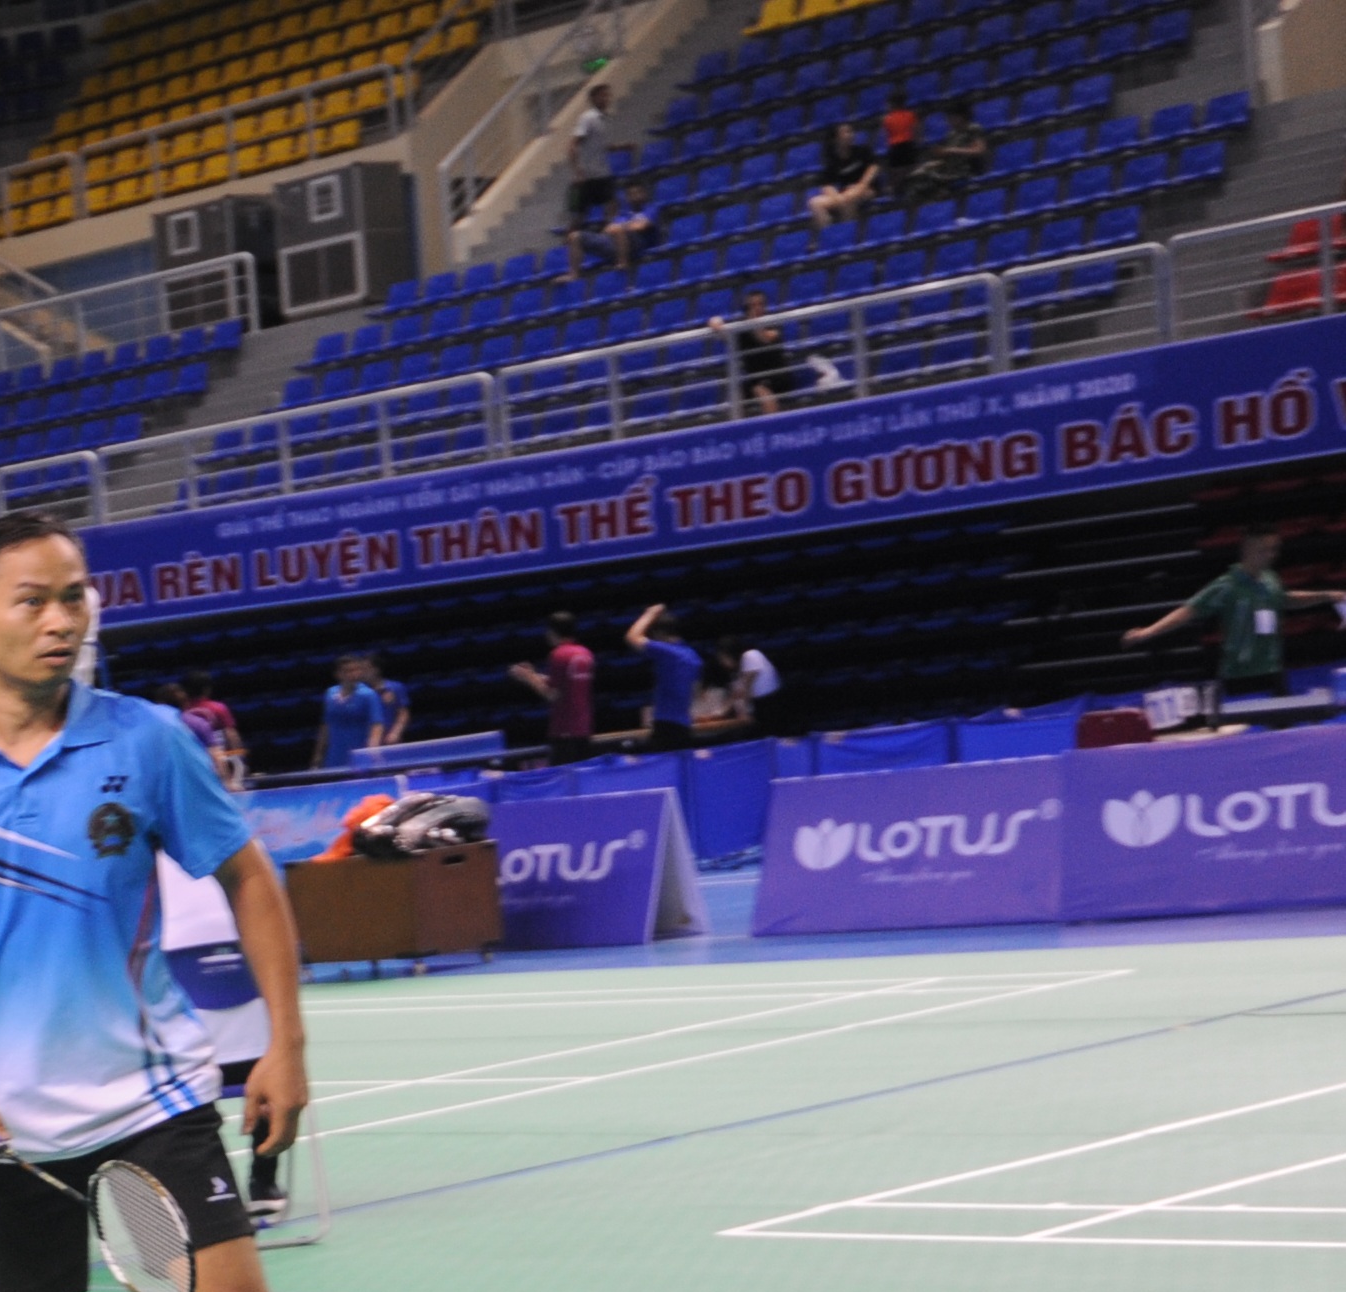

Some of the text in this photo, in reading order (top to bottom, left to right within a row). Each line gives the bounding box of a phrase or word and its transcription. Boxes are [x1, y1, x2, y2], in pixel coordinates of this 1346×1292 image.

[91, 569, 143, 609] UA
[255, 530, 399, 590] LUYỆN
[411, 508, 542, 566] THÂN
[557, 476, 654, 546] THỂ
[669, 469, 810, 529] THEO
[828, 431, 1042, 507] GƯƠNG
[1058, 403, 1198, 472] BÁC
[856, 809, 1037, 864] LOTUS
